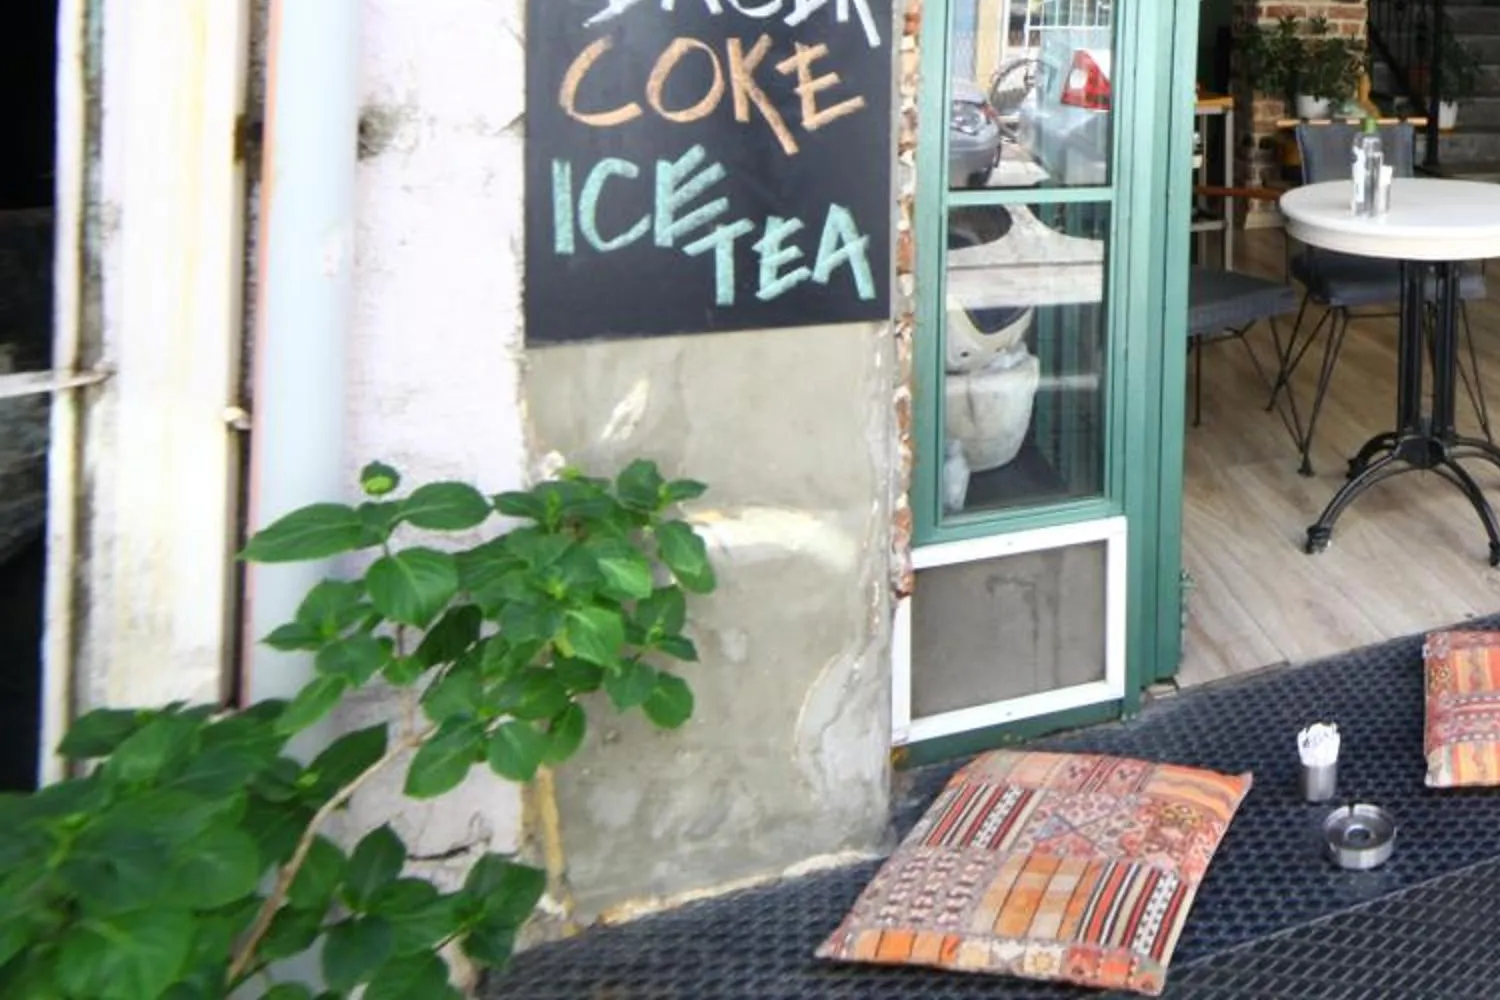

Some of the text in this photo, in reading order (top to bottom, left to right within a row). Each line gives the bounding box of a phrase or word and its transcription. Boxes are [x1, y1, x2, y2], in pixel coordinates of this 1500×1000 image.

[558, 34, 866, 155] COKE
[551, 144, 876, 305] ICE TEA
